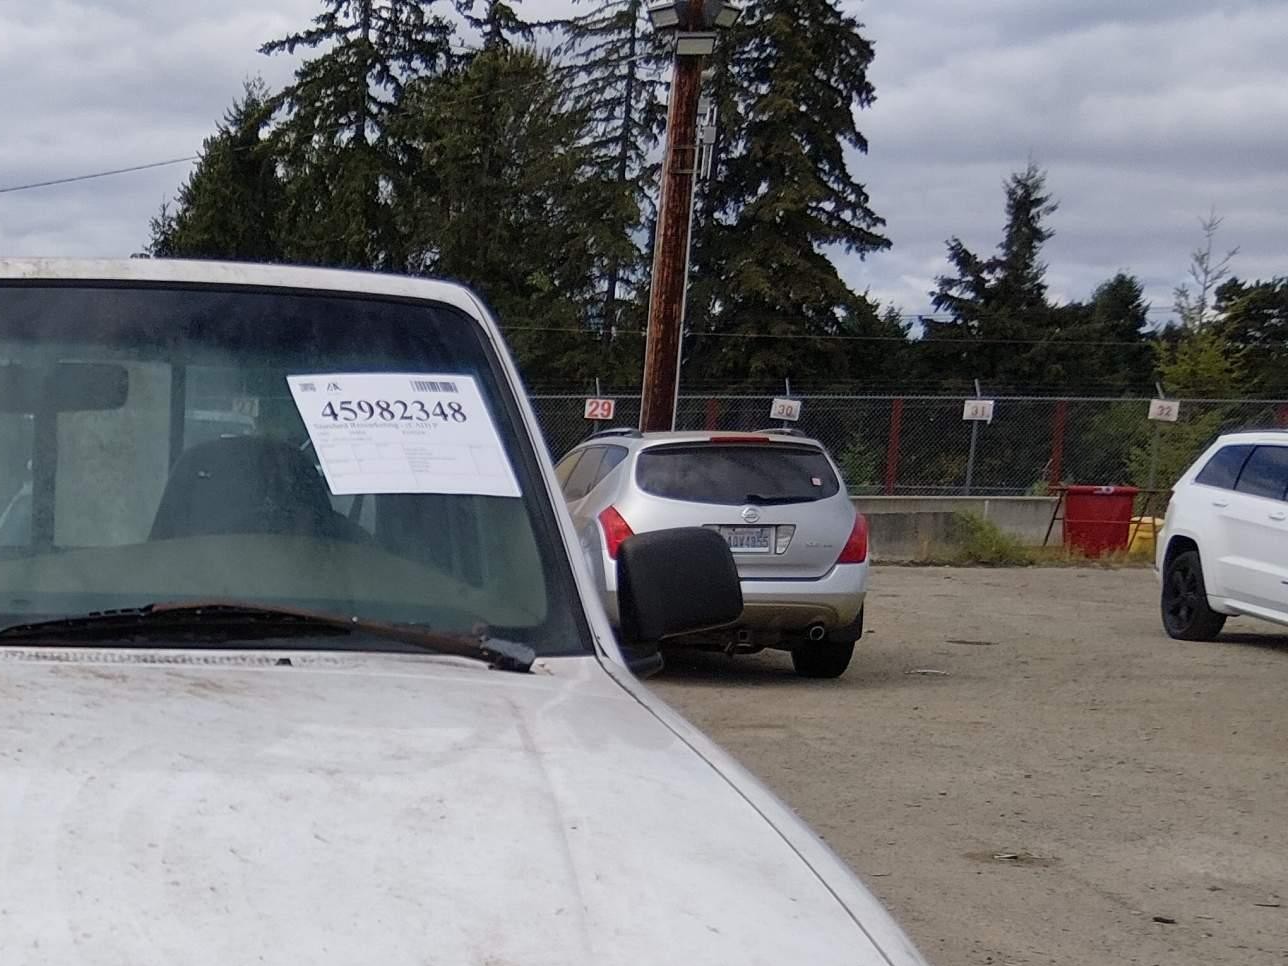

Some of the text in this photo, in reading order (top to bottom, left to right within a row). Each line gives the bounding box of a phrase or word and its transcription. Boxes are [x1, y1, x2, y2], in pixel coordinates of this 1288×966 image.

[321, 400, 467, 423] 45982348
[588, 400, 612, 418] 29
[778, 404, 793, 417] 30
[971, 405, 985, 417] 31
[1157, 405, 1172, 417] 32
